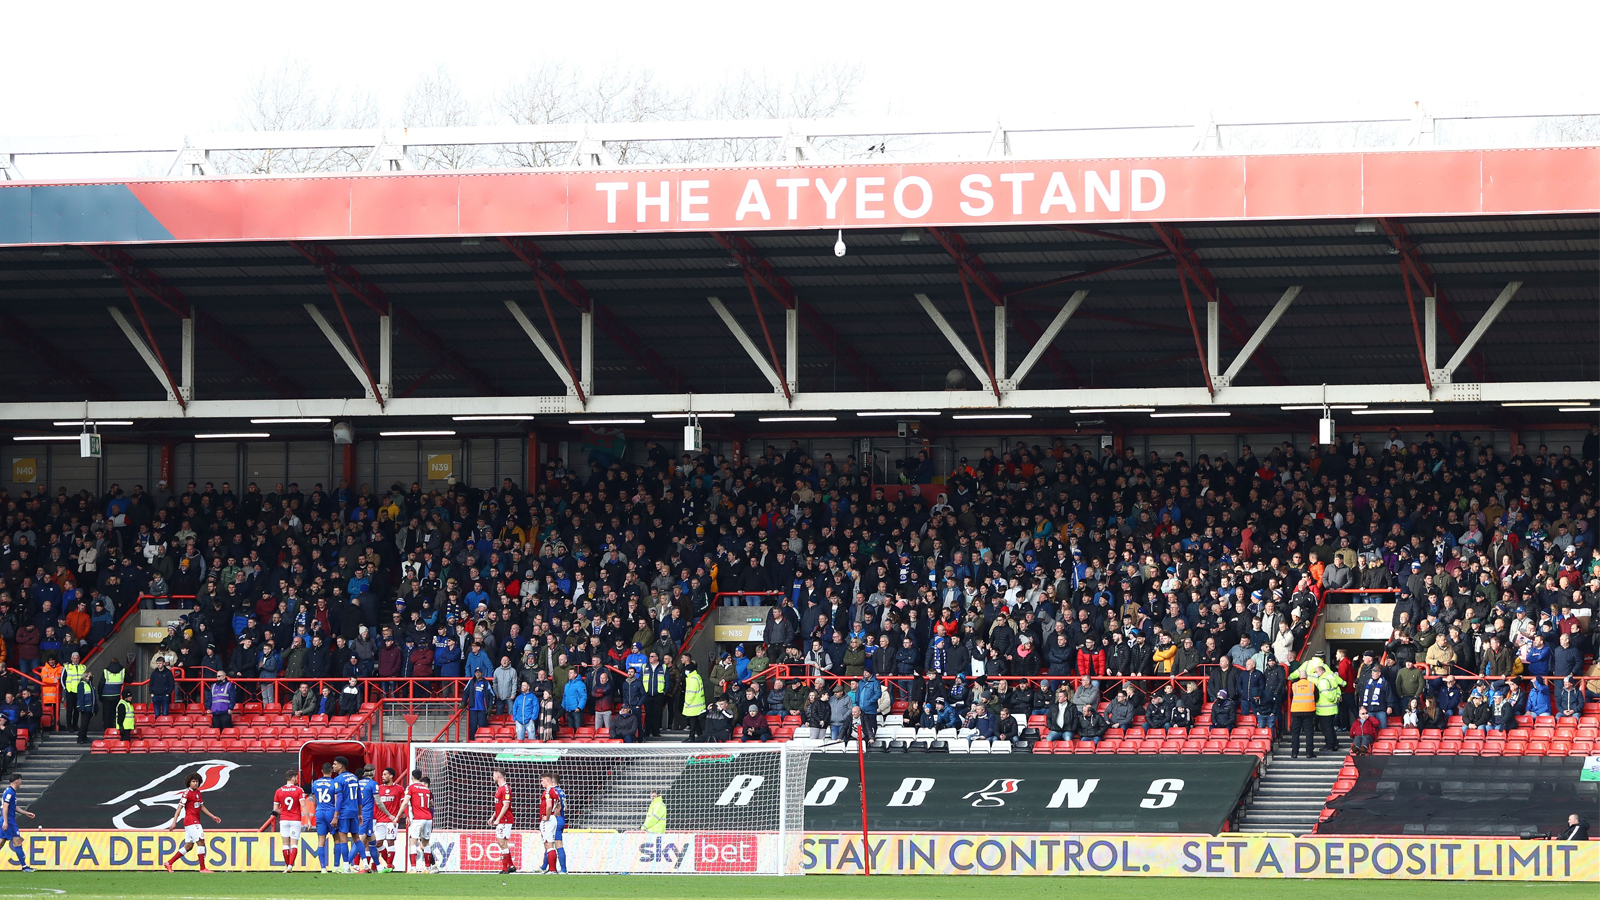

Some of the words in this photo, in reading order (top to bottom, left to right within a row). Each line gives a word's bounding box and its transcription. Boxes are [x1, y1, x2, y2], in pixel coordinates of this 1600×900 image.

[595, 179, 711, 224] THE
[735, 174, 934, 221] ATYEO
[958, 169, 1167, 217] STAND
[16, 466, 34, 475] N40
[432, 463, 449, 471] N39
[147, 631, 162, 639] N40
[1340, 627, 1356, 635] N38
[316, 787, 332, 803] 16
[417, 792, 431, 808] 11
[284, 796, 294, 811] 9
[73, 836, 99, 866] A
[639, 836, 689, 869] sky
[701, 837, 751, 863] bet
[798, 838, 887, 870] STAY
[897, 839, 936, 870] IN
[949, 839, 1150, 872] CONTROL.
[1182, 841, 1248, 873] SET
[1255, 842, 1284, 874] A
[1295, 842, 1462, 876] DEPOSIT
[1474, 843, 1579, 877] LIMIT
